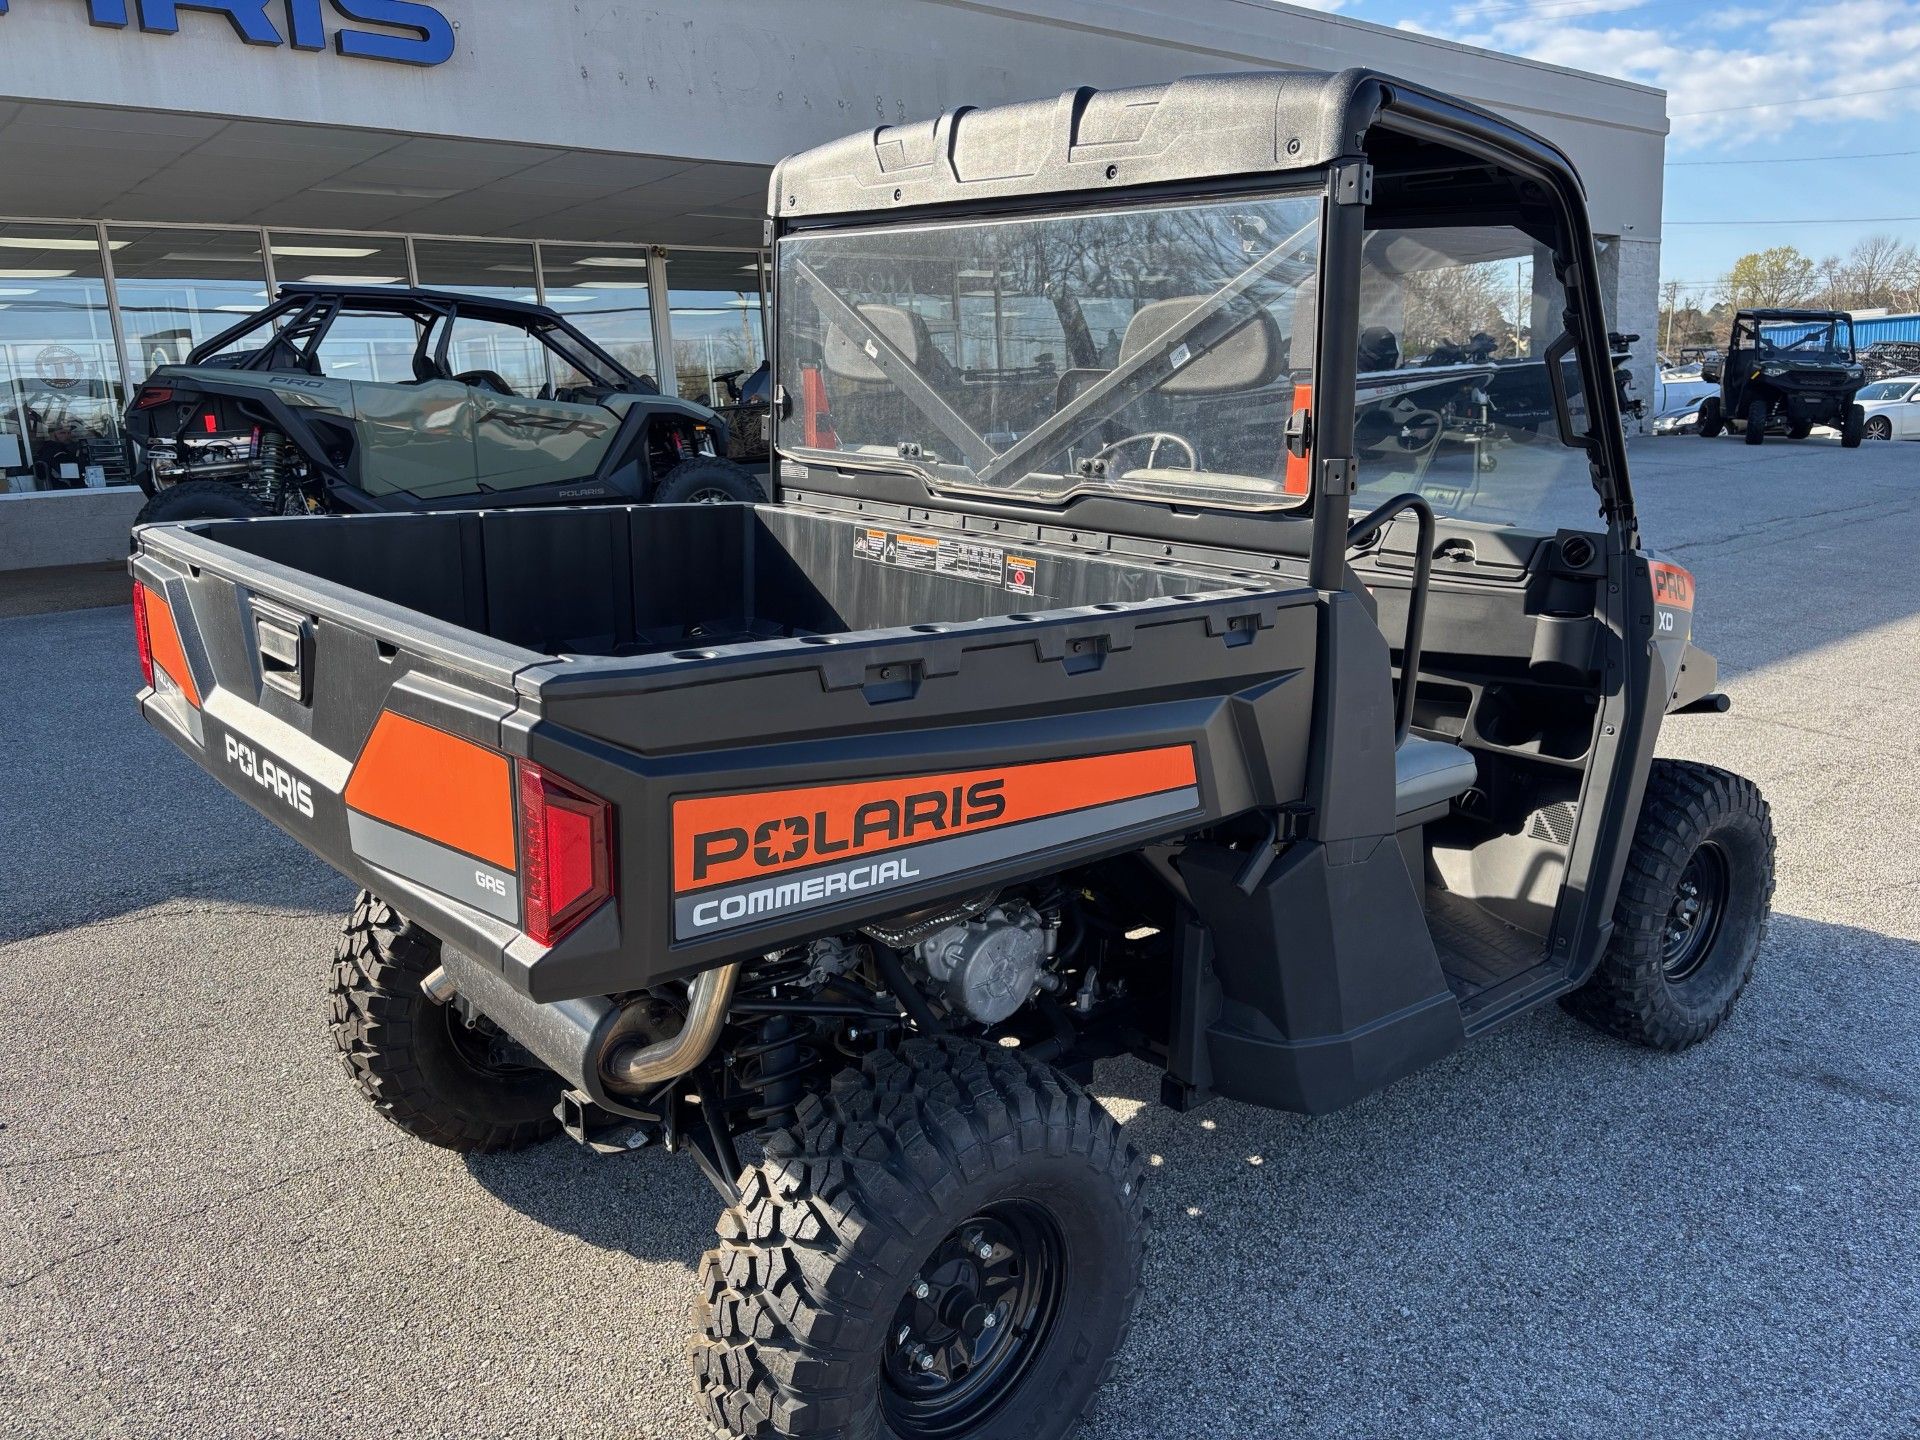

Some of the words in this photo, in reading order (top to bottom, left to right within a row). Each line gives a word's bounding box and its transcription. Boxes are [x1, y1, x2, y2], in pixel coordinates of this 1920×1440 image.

[269, 376, 325, 388] PRO
[476, 408, 608, 439] RZR
[559, 487, 605, 498] POLARIS
[1655, 569, 1686, 601] PRO
[1658, 611, 1673, 631] XD
[224, 732, 314, 819] POLARIS
[693, 779, 1006, 881] POLARIS
[475, 870, 506, 897] GAS
[692, 857, 920, 927] COMMERCIAL
